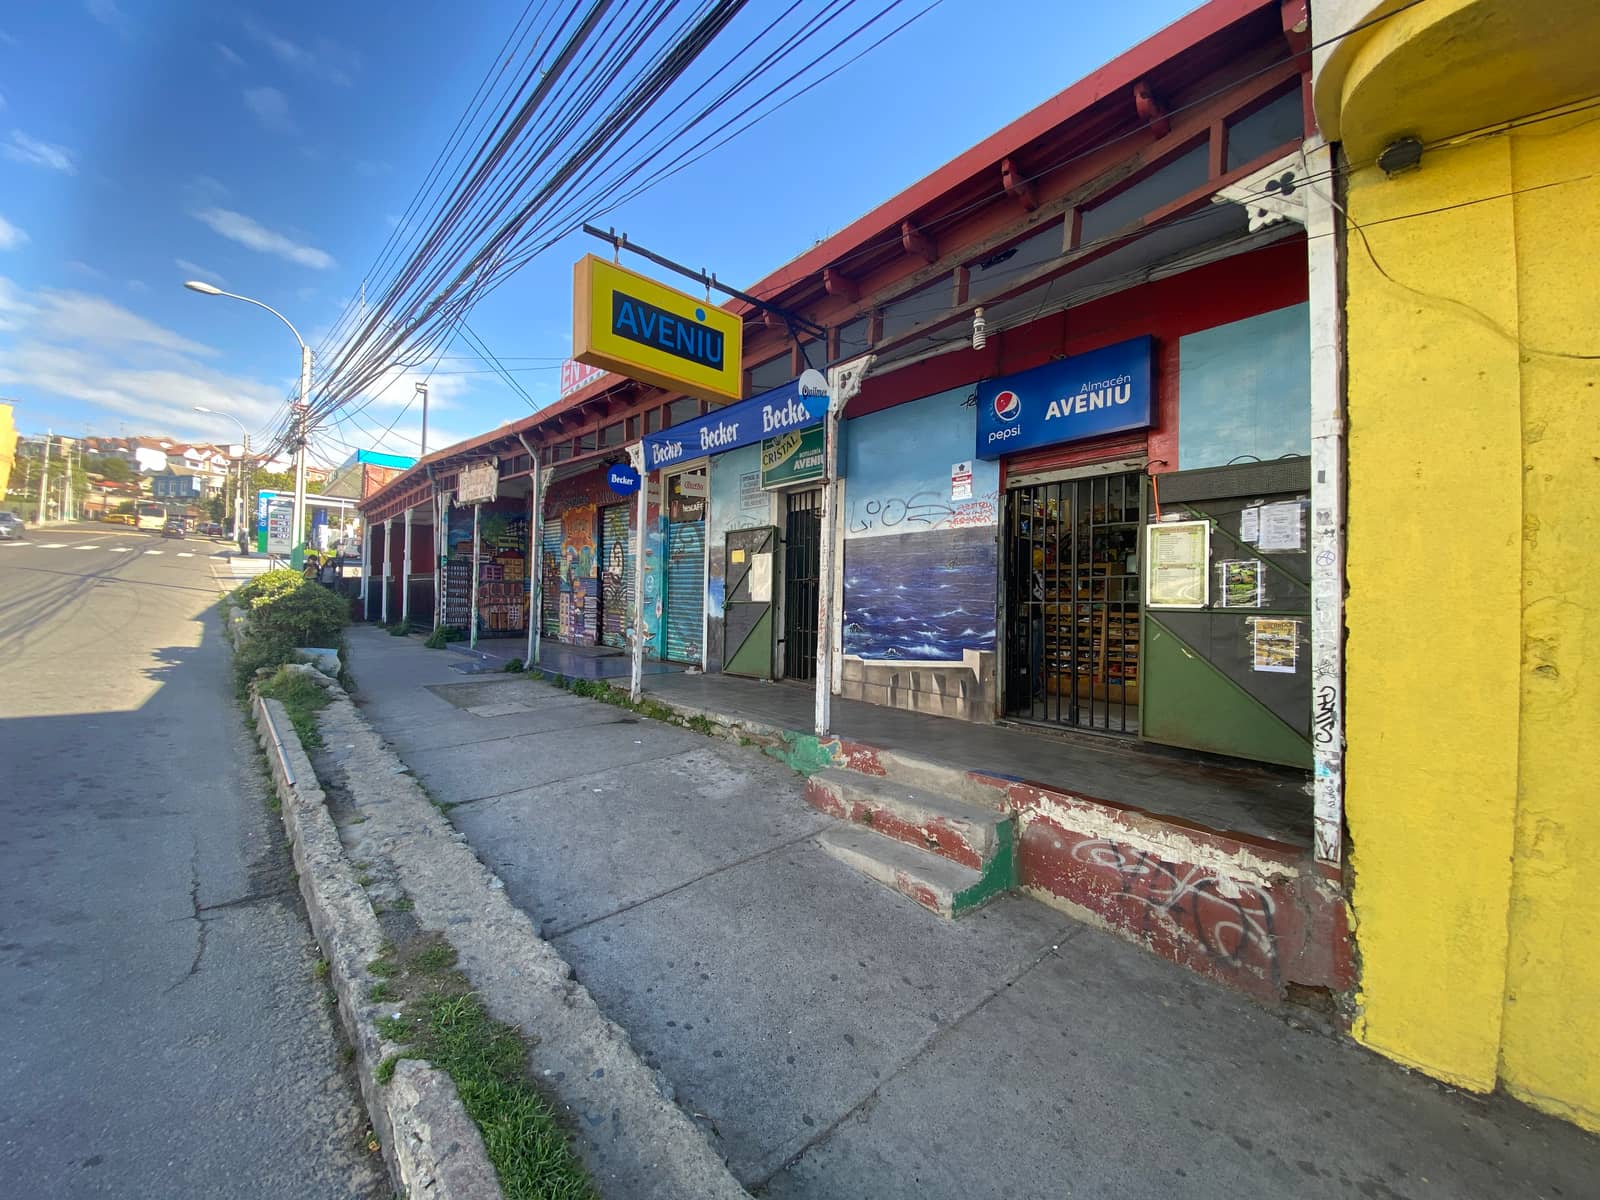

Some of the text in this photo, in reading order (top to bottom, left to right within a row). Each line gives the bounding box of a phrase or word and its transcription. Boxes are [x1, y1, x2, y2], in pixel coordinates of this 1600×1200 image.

[616, 301, 721, 362] AVENIU
[1080, 374, 1131, 393] Almacén
[1044, 384, 1131, 421] AVENIU
[700, 422, 739, 450] Becker
[988, 424, 1020, 444] pepsi
[763, 436, 798, 465] CRISTAL
[611, 474, 634, 486] Becker
